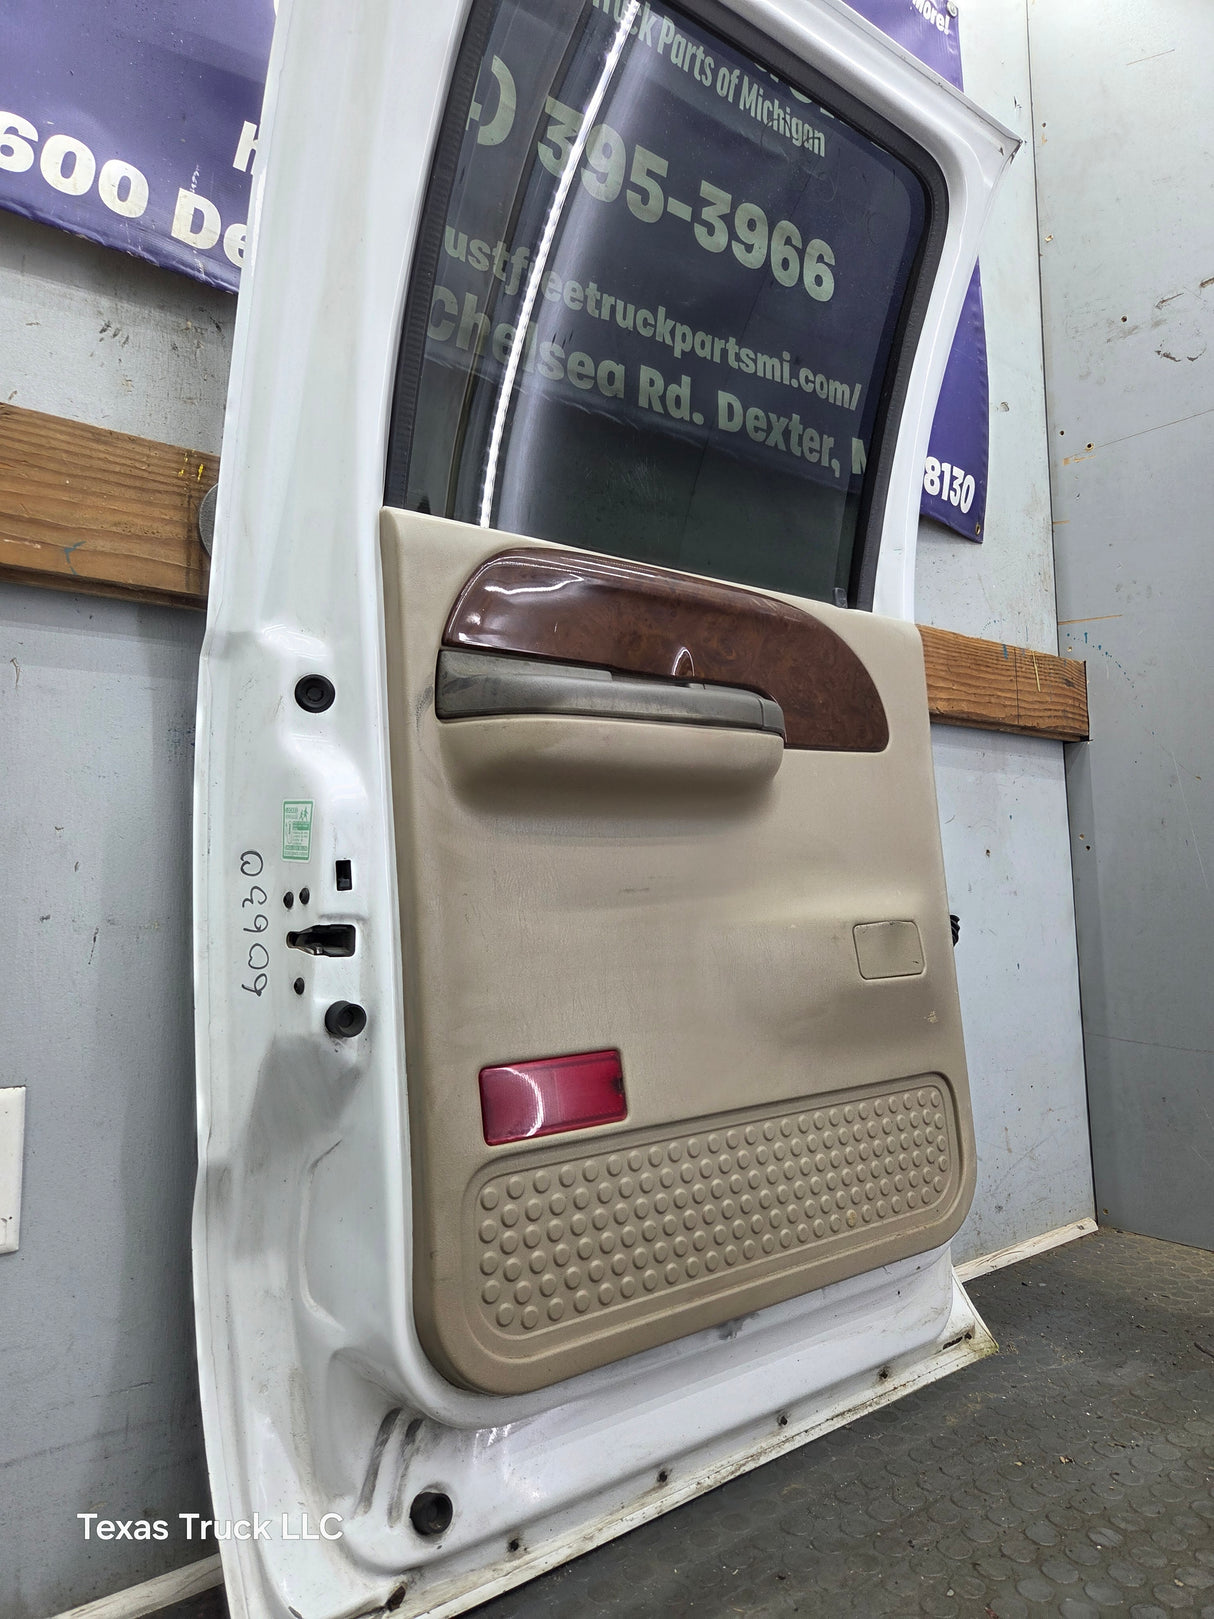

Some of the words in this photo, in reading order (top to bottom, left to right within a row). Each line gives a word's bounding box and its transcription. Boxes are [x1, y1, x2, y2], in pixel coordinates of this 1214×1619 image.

[657, 15, 714, 87] Parts
[716, 66, 741, 103] of
[738, 75, 825, 157] Michigan
[538, 95, 836, 302] 395-3966
[427, 284, 625, 398] Chelsea
[638, 365, 704, 425] Rd.
[718, 390, 841, 478] Dexter,
[923, 456, 976, 514] 8130
